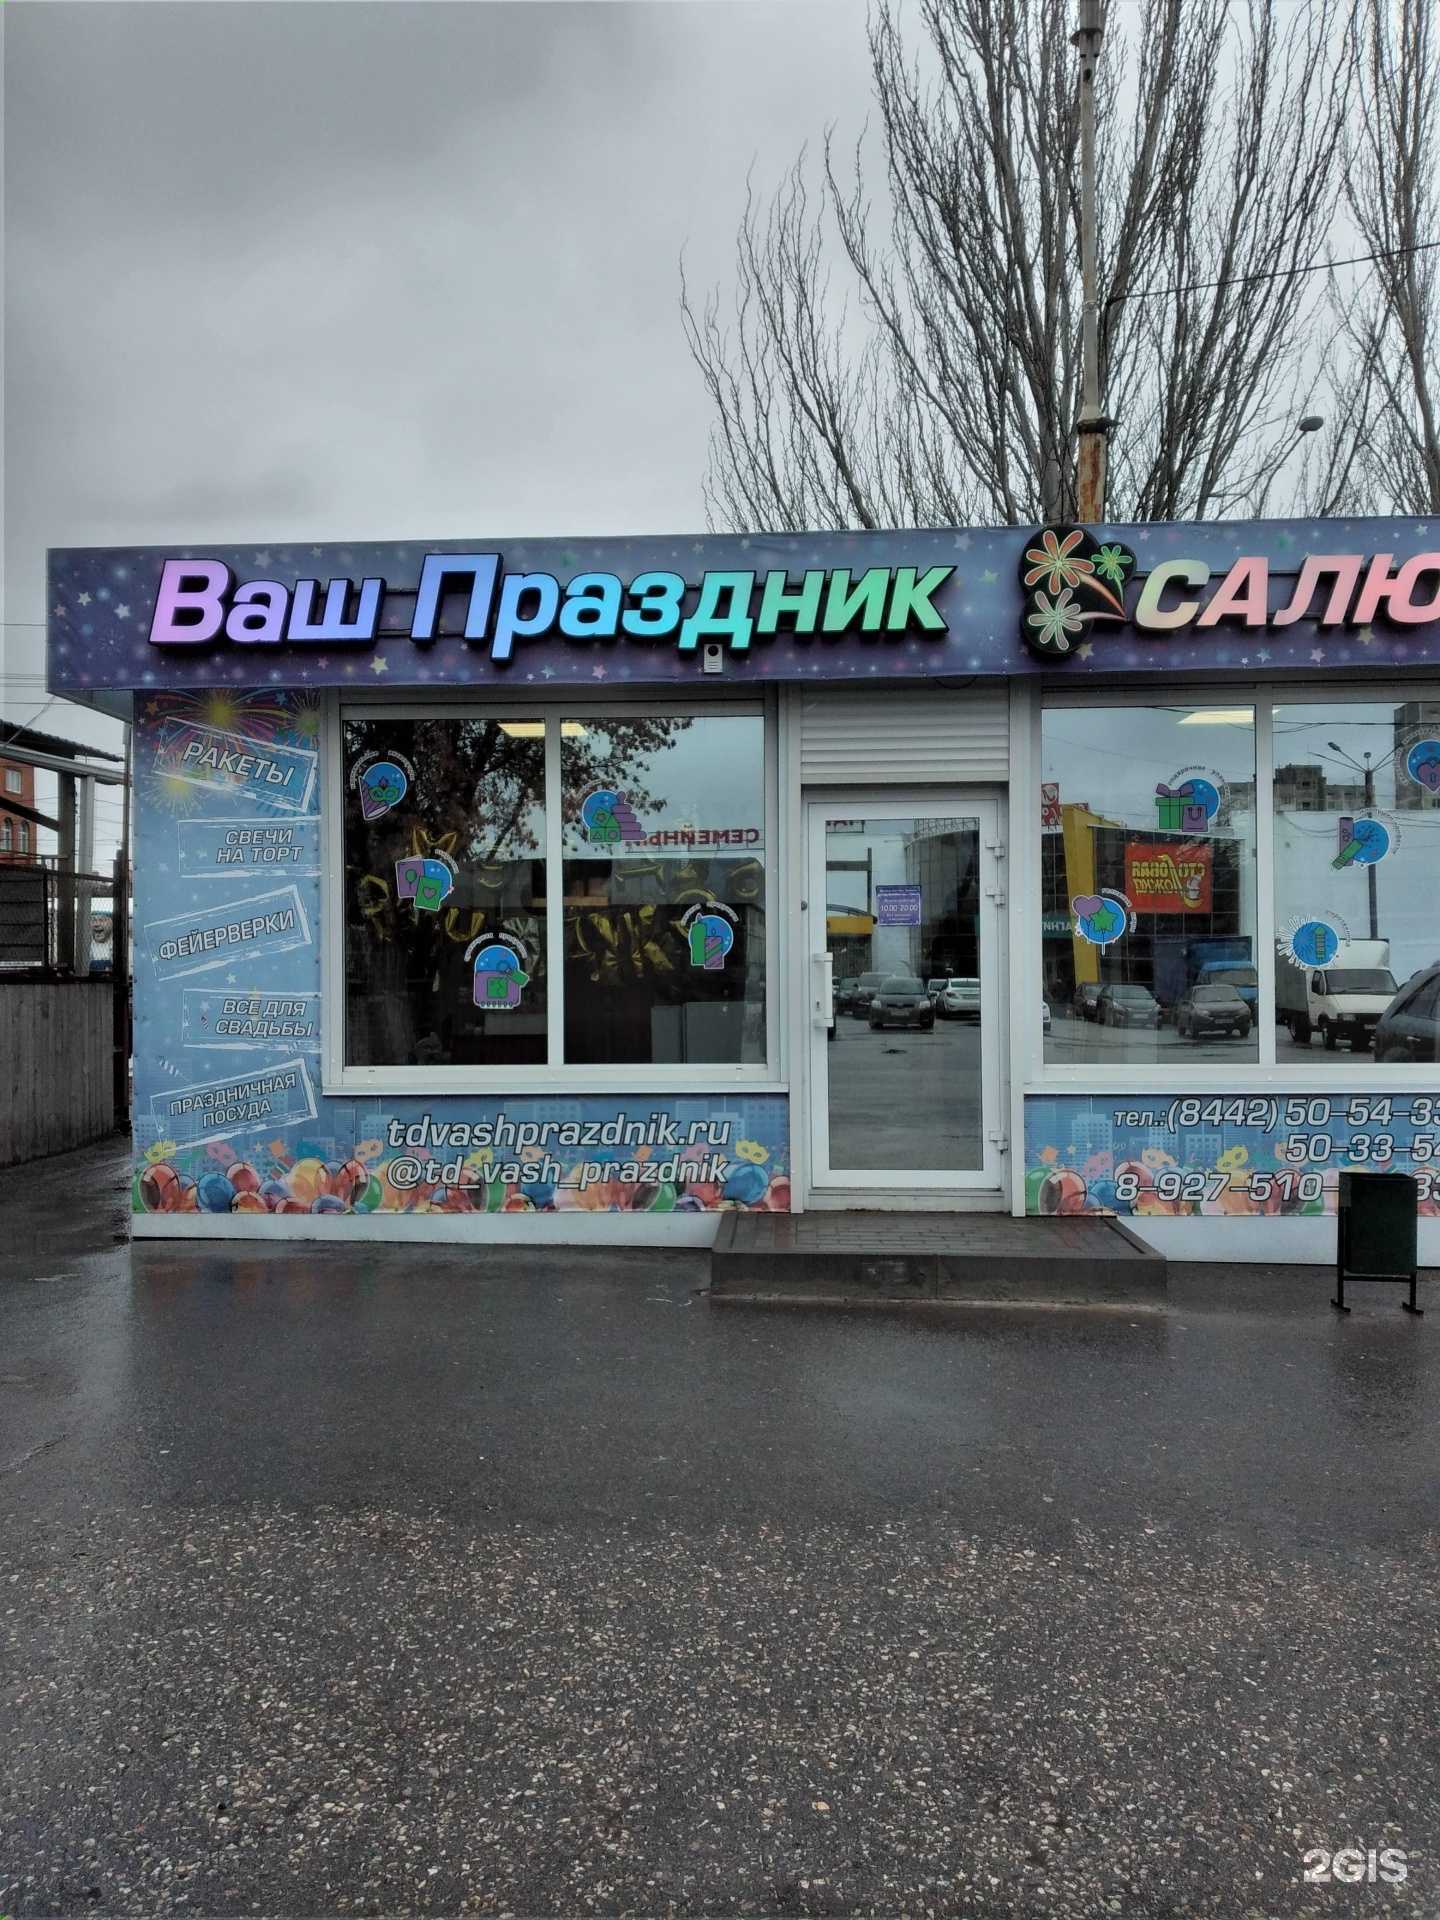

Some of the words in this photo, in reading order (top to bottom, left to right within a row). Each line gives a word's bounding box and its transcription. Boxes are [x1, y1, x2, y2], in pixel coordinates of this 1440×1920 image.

[148, 557, 384, 647] Ваш
[410, 552, 954, 662] Праздник
[182, 741, 295, 786] РАКЕТЫ
[216, 847, 245, 863] НА
[252, 846, 303, 862] ТОРТ
[225, 828, 294, 846] СВЕЧИ
[159, 909, 295, 961] ФЕЙЕРВЕРКИ
[223, 999, 261, 1015] ВСЕ
[263, 1001, 306, 1018] ДЛЯ
[215, 1020, 313, 1038] СВАДЬБЫ
[169, 1073, 296, 1116] ПРАЗДНИЧНАЯ
[202, 1100, 272, 1128] ПОСУДА
[387, 1112, 732, 1154] tdvashprazdnik.ru
[386, 1154, 731, 1190] @td_vash_prazdnik
